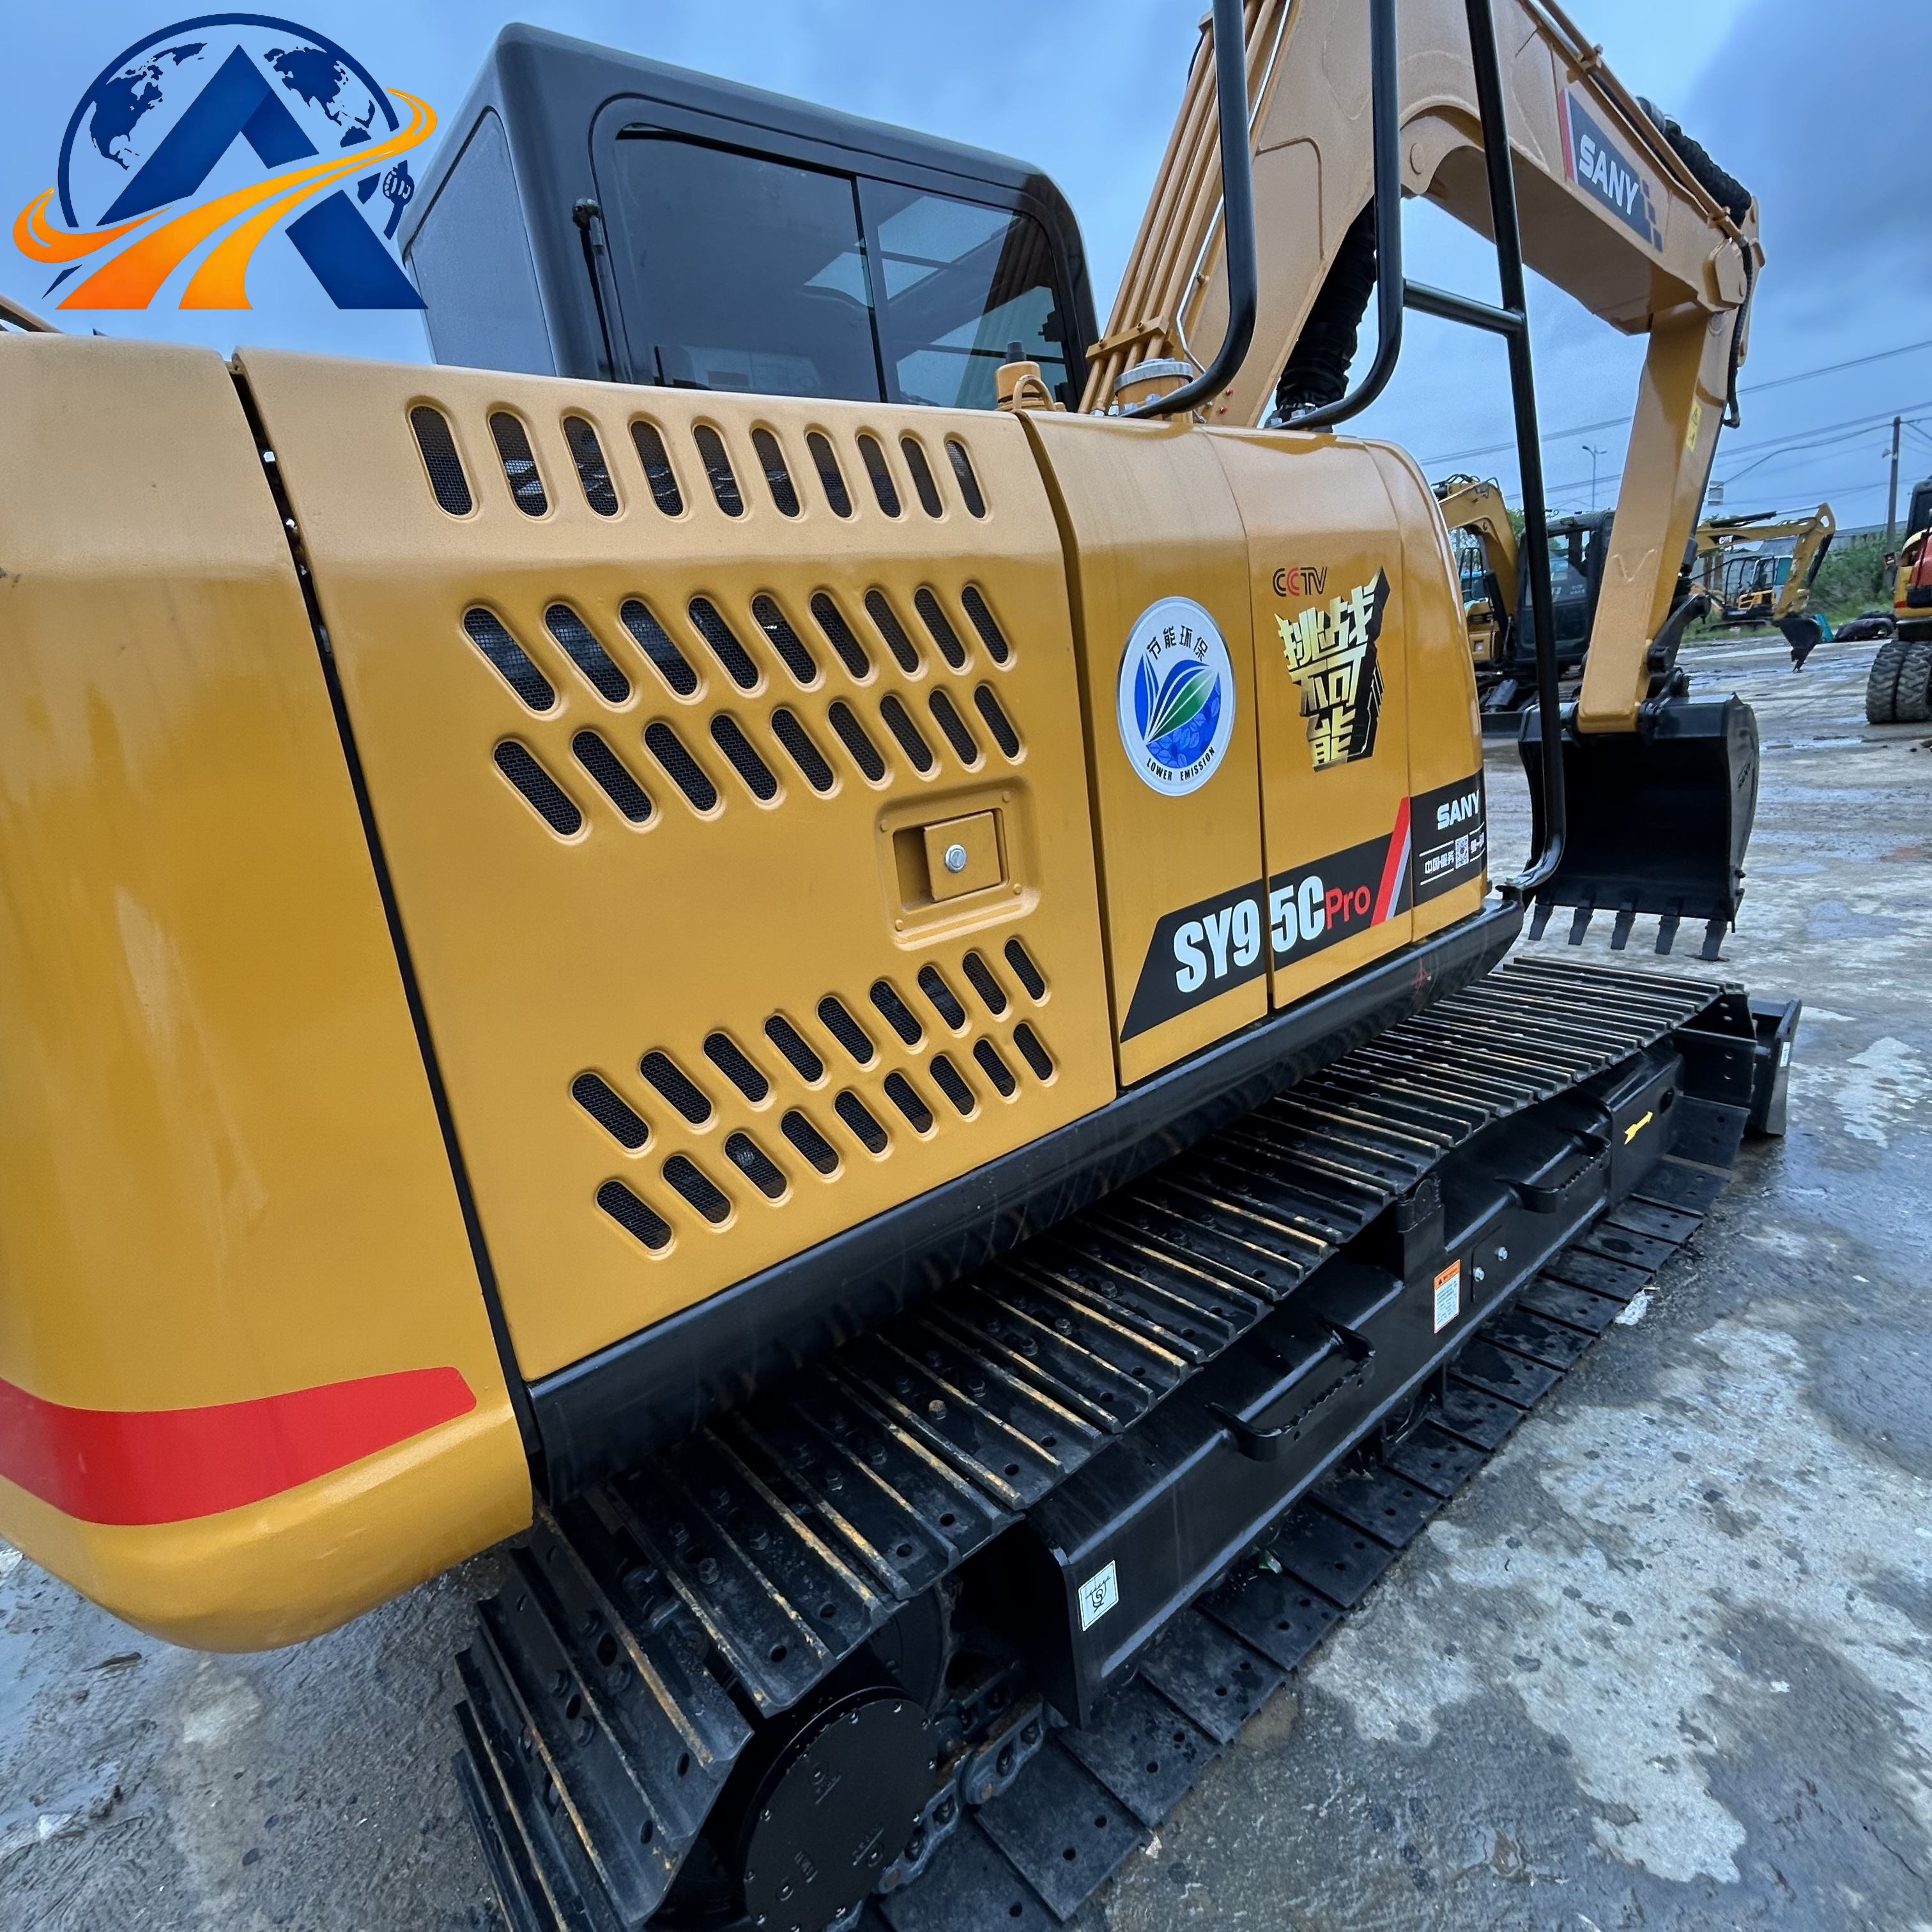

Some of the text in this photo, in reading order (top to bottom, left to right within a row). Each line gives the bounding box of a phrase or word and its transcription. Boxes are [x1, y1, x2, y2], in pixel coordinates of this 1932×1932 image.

[1579, 134, 1639, 215] SANY
[1272, 567, 1328, 597] CCTV
[1275, 566, 1382, 670] 挑战
[1147, 625, 1209, 662] 节能环保
[1147, 746, 1216, 781] LOWER EMISSION
[1438, 790, 1480, 831] SANY
